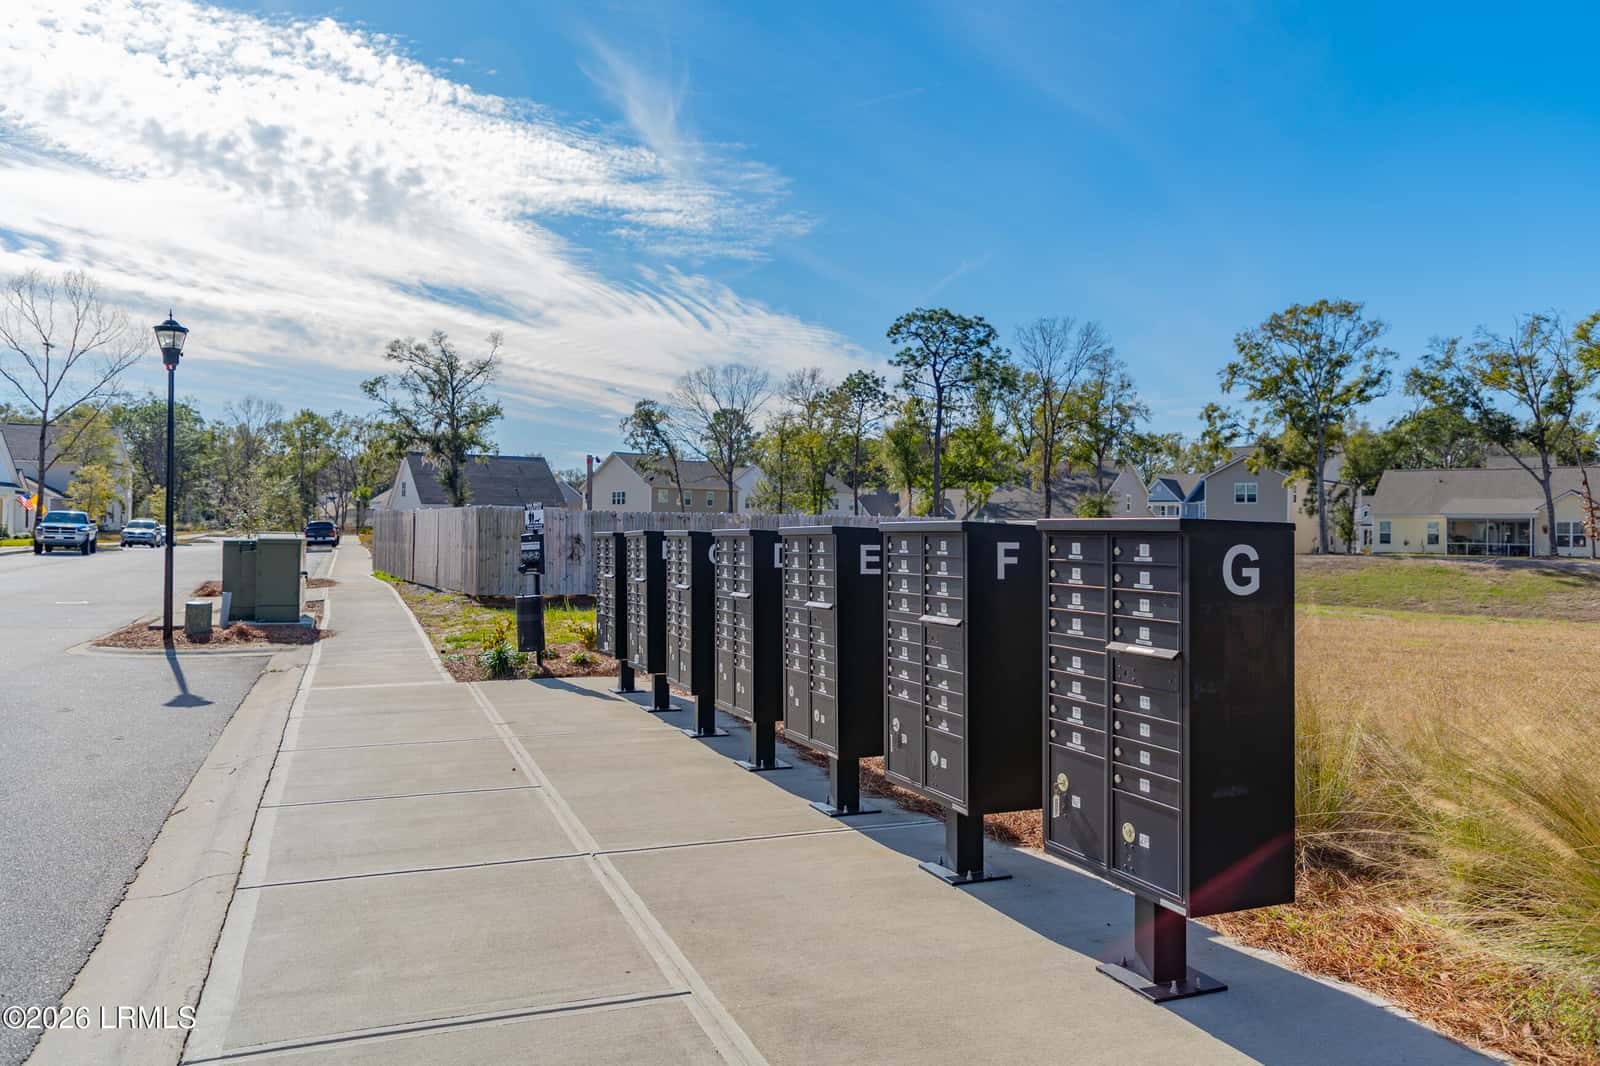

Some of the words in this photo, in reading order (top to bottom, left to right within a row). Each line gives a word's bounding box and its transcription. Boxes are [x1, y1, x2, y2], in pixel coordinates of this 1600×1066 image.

[860, 544, 882, 575] E
[996, 541, 1020, 580] F
[1222, 544, 1260, 596] G
